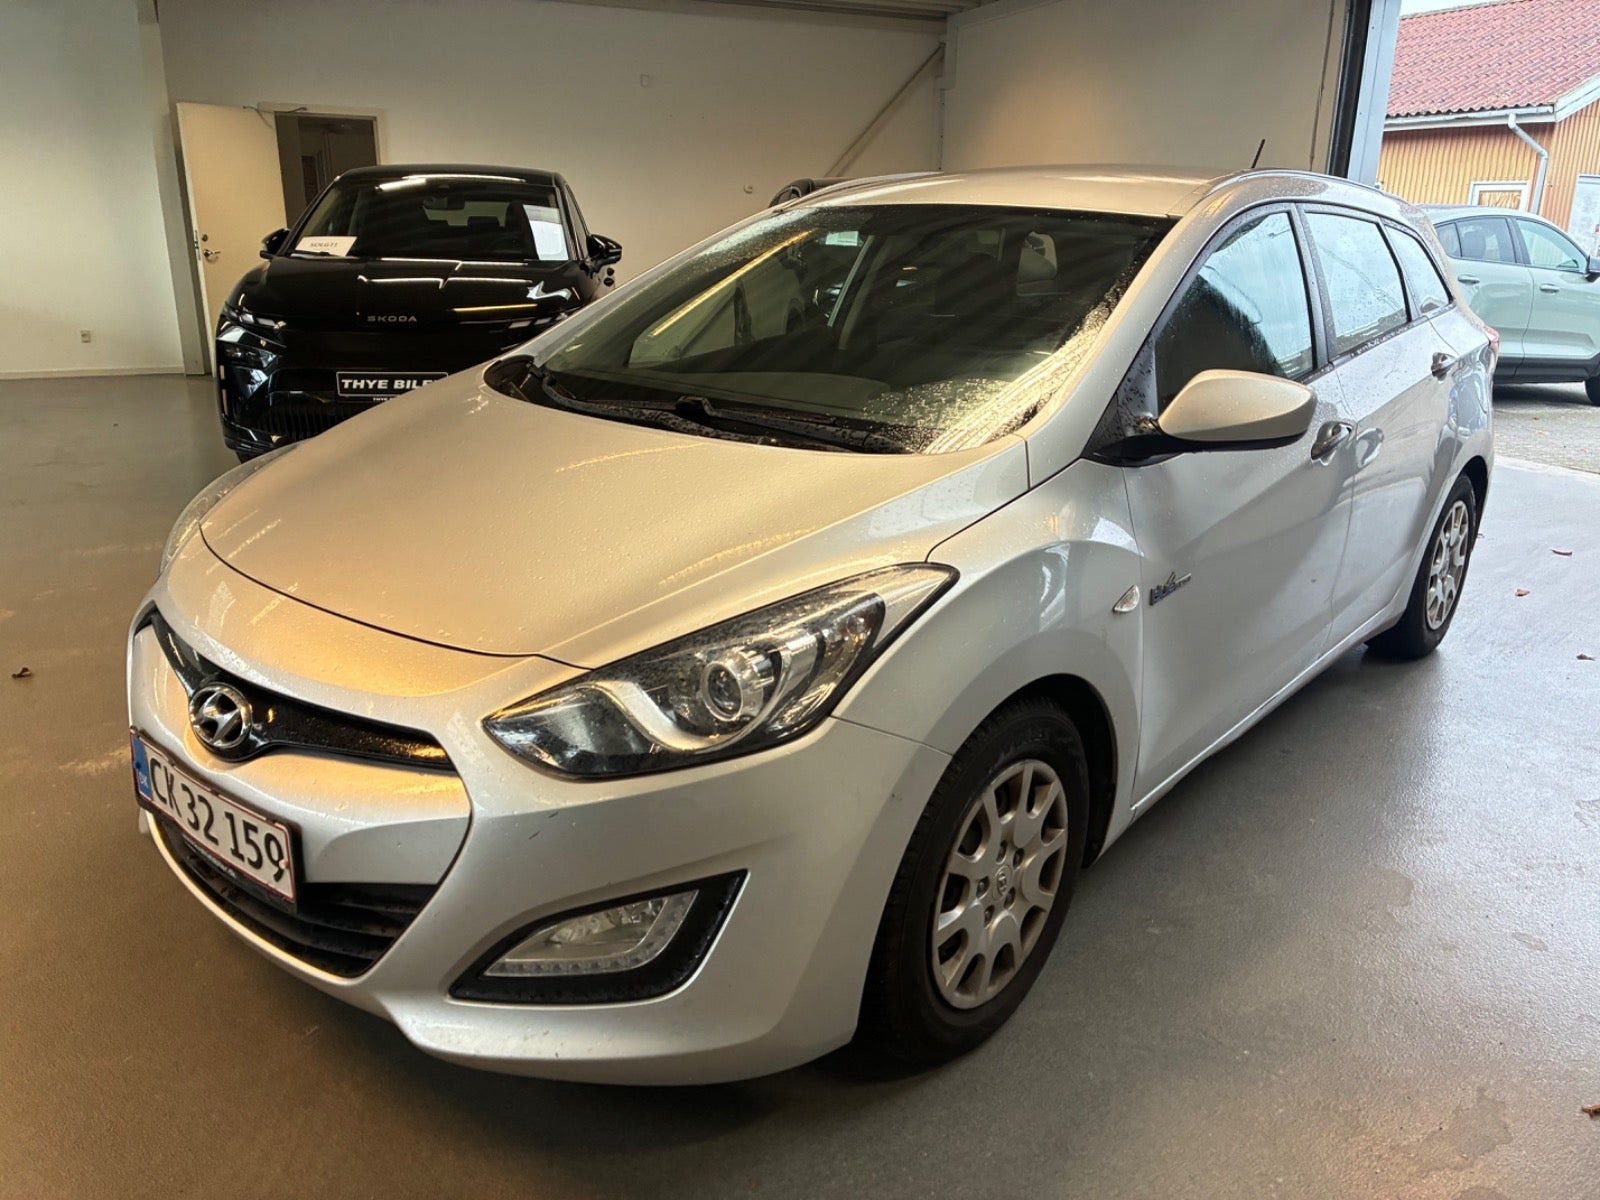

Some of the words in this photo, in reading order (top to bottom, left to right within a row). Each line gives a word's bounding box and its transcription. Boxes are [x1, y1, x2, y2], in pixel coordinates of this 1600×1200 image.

[341, 379, 389, 389] THYE
[393, 379, 436, 390] BIL
[150, 757, 182, 818] CK
[181, 783, 219, 846] 32
[224, 811, 285, 883] 159
